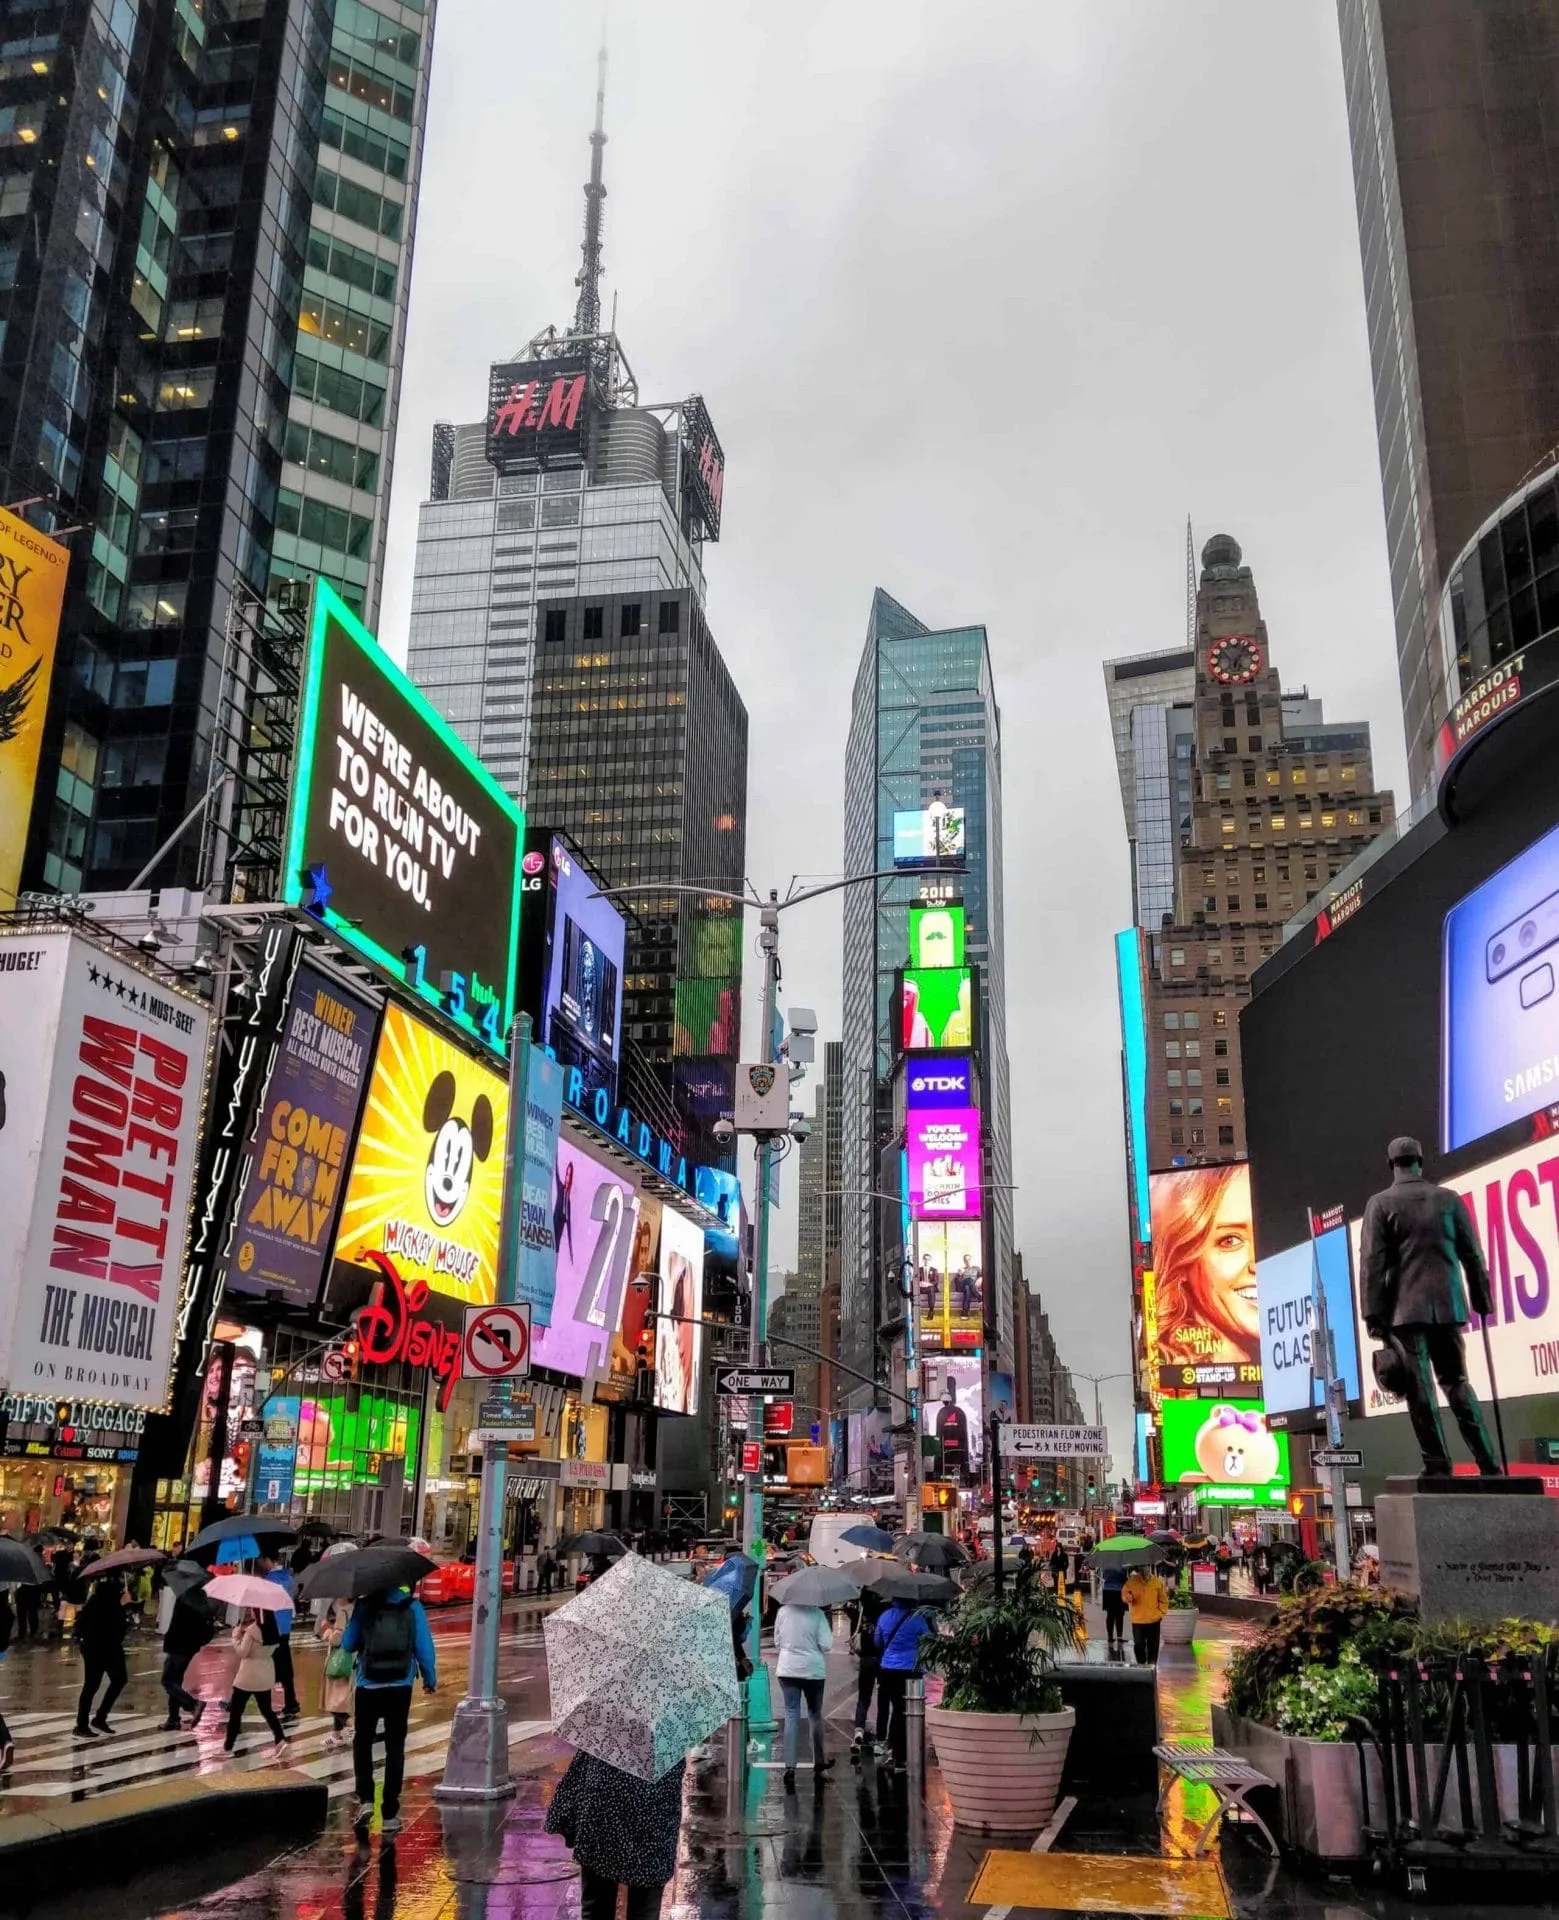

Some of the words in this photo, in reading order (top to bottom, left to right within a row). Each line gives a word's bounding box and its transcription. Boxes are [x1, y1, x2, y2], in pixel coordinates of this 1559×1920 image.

[493, 375, 586, 436] H&M
[1455, 655, 1526, 721] MARRIOTT
[1458, 683, 1518, 741] MARQUIS
[335, 734, 371, 796] TO
[427, 831, 458, 880] TV
[413, 766, 482, 858] ABOUT
[329, 788, 380, 866] FOR
[382, 835, 432, 913] YOU.
[561, 857, 571, 877] LG
[521, 877, 542, 891] LG
[920, 886, 954, 899] 2018
[1331, 879, 1364, 914] MARRIOTT
[27, 892, 90, 912] LAMAR
[1331, 895, 1362, 929] MARQUIS
[140, 991, 147, 1011] A
[286, 1036, 299, 1056] ALL
[290, 1007, 322, 1048] BEST
[318, 1024, 363, 1075] MUSICAL
[924, 1076, 966, 1091] TDK
[49, 1013, 139, 1281] WOMAN
[271, 1099, 347, 1167] COME
[110, 1032, 189, 1304] PRETTY
[248, 1184, 331, 1245] AWAY
[522, 1200, 546, 1227] EVAN
[384, 1220, 434, 1266] MICKEY
[433, 1240, 480, 1284] MOUSE
[40, 1284, 78, 1349] THE
[80, 1296, 157, 1362] MUSICAL
[1267, 1294, 1312, 1337] FUTUR
[1175, 1326, 1212, 1343] SARAH
[1272, 1333, 1311, 1371] CLAS
[34, 1361, 58, 1378] ON
[64, 1365, 151, 1393] BROADWAY
[727, 1376, 749, 1388] ONE
[761, 1376, 785, 1389] WAY
[1196, 1371, 1237, 1383] STAND-UP
[1240, 1364, 1263, 1382] FRI
[2, 1396, 57, 1425] GIFTS
[69, 1404, 147, 1434] LUGGAGE
[1013, 1428, 1059, 1440] PEDESTRIAN
[1060, 1429, 1081, 1440] FLOW
[1083, 1430, 1103, 1440] ZONE
[1053, 1442, 1072, 1453] KEEP
[1074, 1443, 1104, 1453] MOVING
[86, 1447, 116, 1459] SONY
[1318, 1454, 1333, 1463] ONE
[1339, 1453, 1357, 1464] WAY
[506, 1477, 538, 1500] FOREVER
